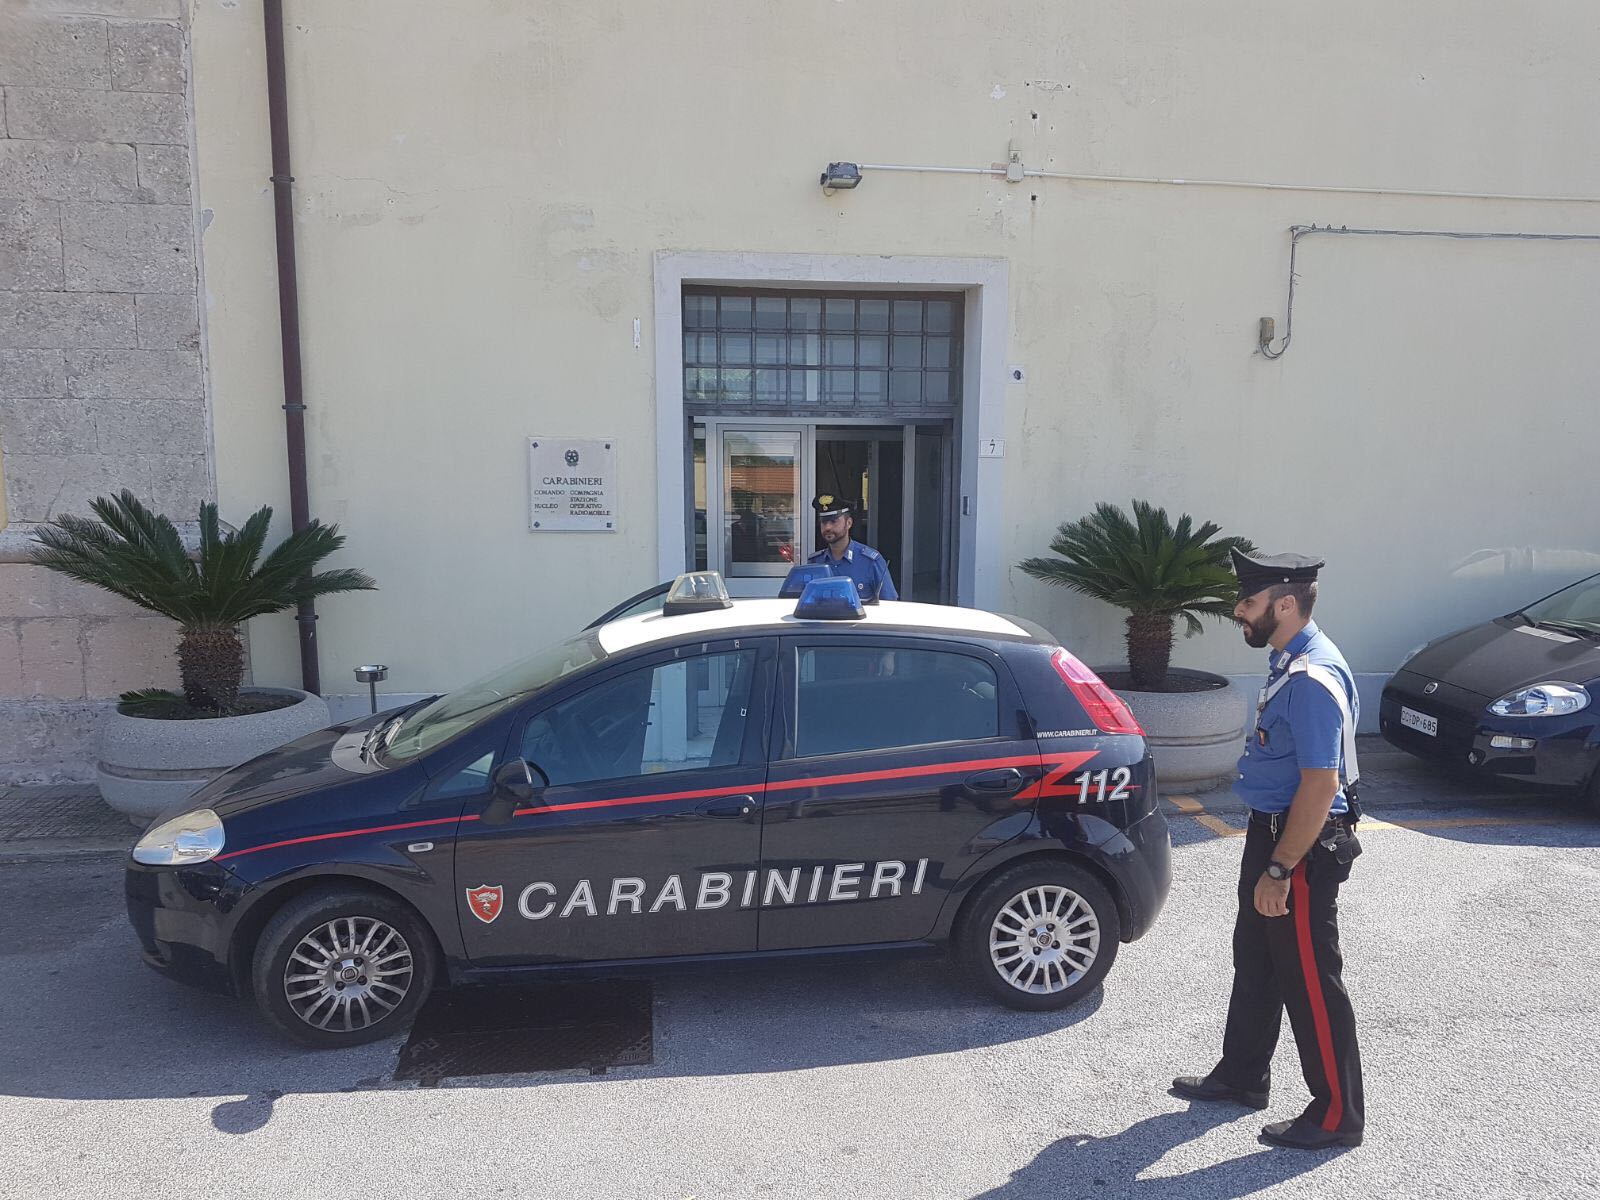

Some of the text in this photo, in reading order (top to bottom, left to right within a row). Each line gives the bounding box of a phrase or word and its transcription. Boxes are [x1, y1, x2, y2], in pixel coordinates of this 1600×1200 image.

[989, 443, 996, 455] 7
[542, 476, 603, 486] CARABINIERI
[1036, 728, 1099, 739] WWW.CARABINIERI.IT
[1074, 766, 1132, 805] 112
[517, 857, 929, 921] CARABINIERI
